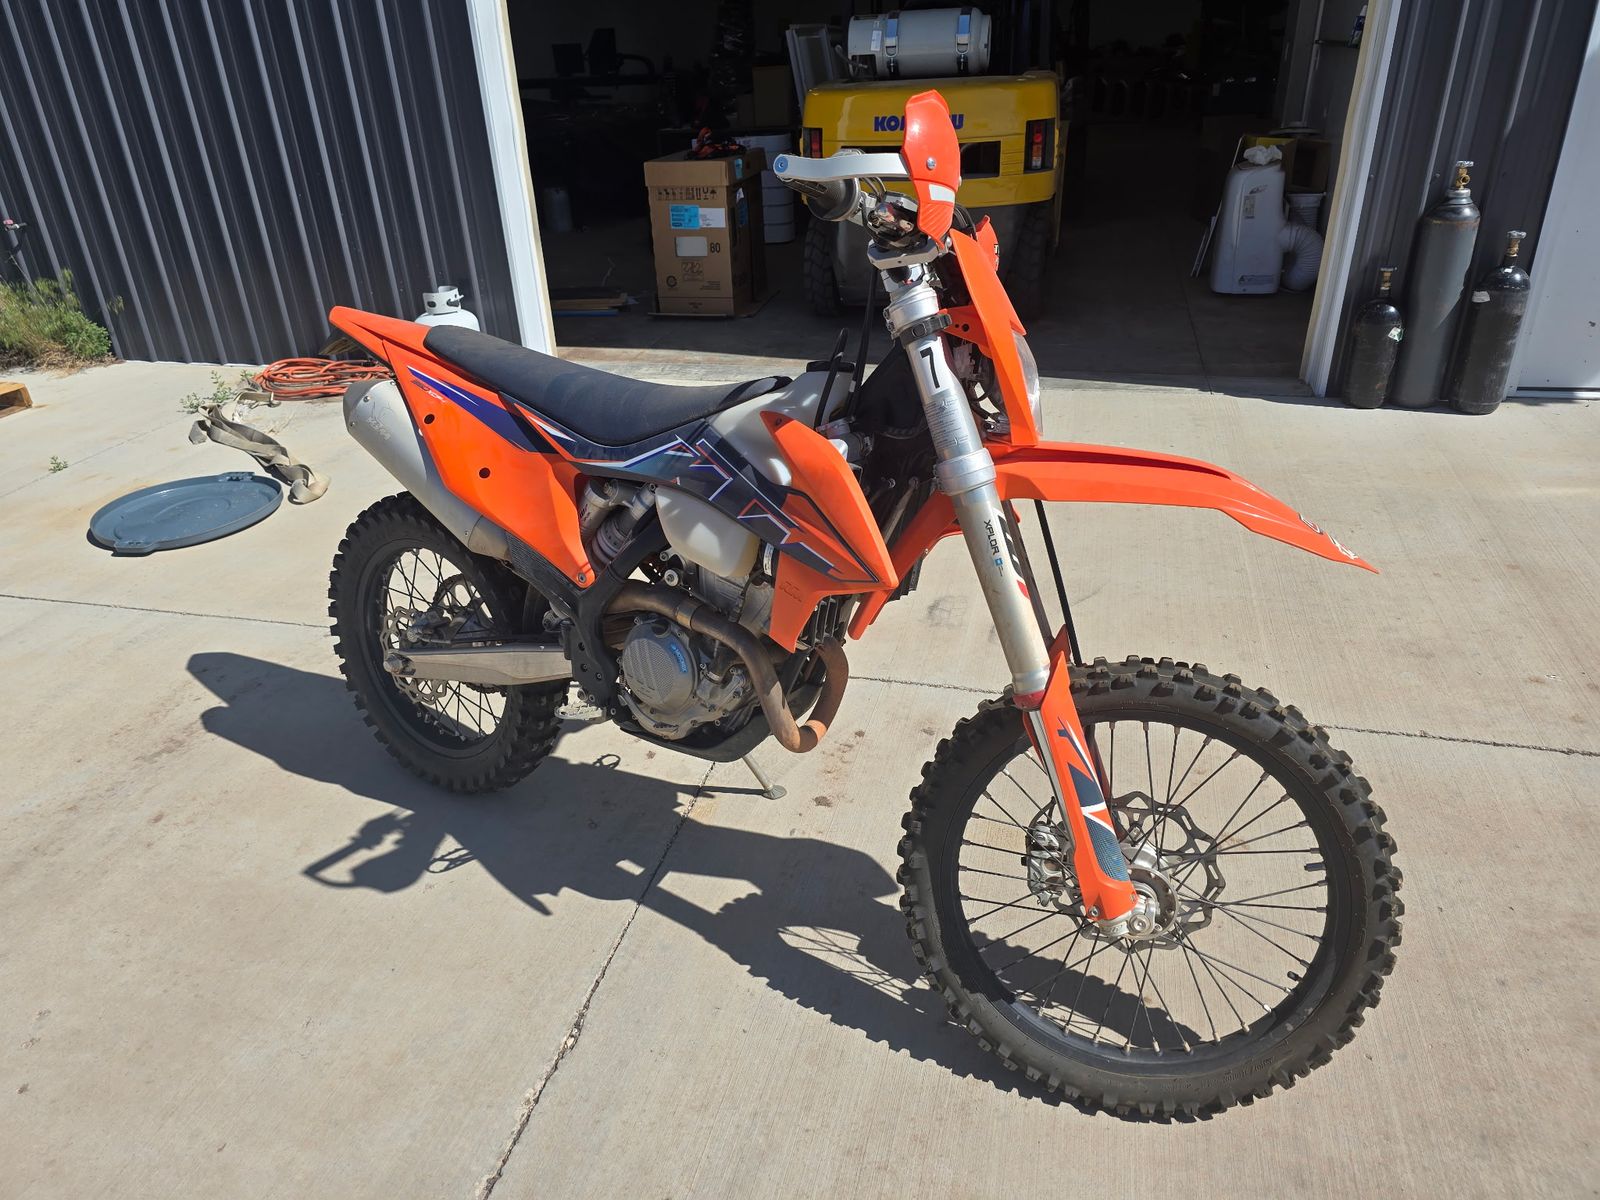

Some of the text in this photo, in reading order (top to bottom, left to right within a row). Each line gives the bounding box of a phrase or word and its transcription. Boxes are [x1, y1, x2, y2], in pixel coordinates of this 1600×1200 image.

[710, 242, 721, 253] 80
[920, 346, 940, 389] 7
[984, 520, 1000, 556] XPLOR
